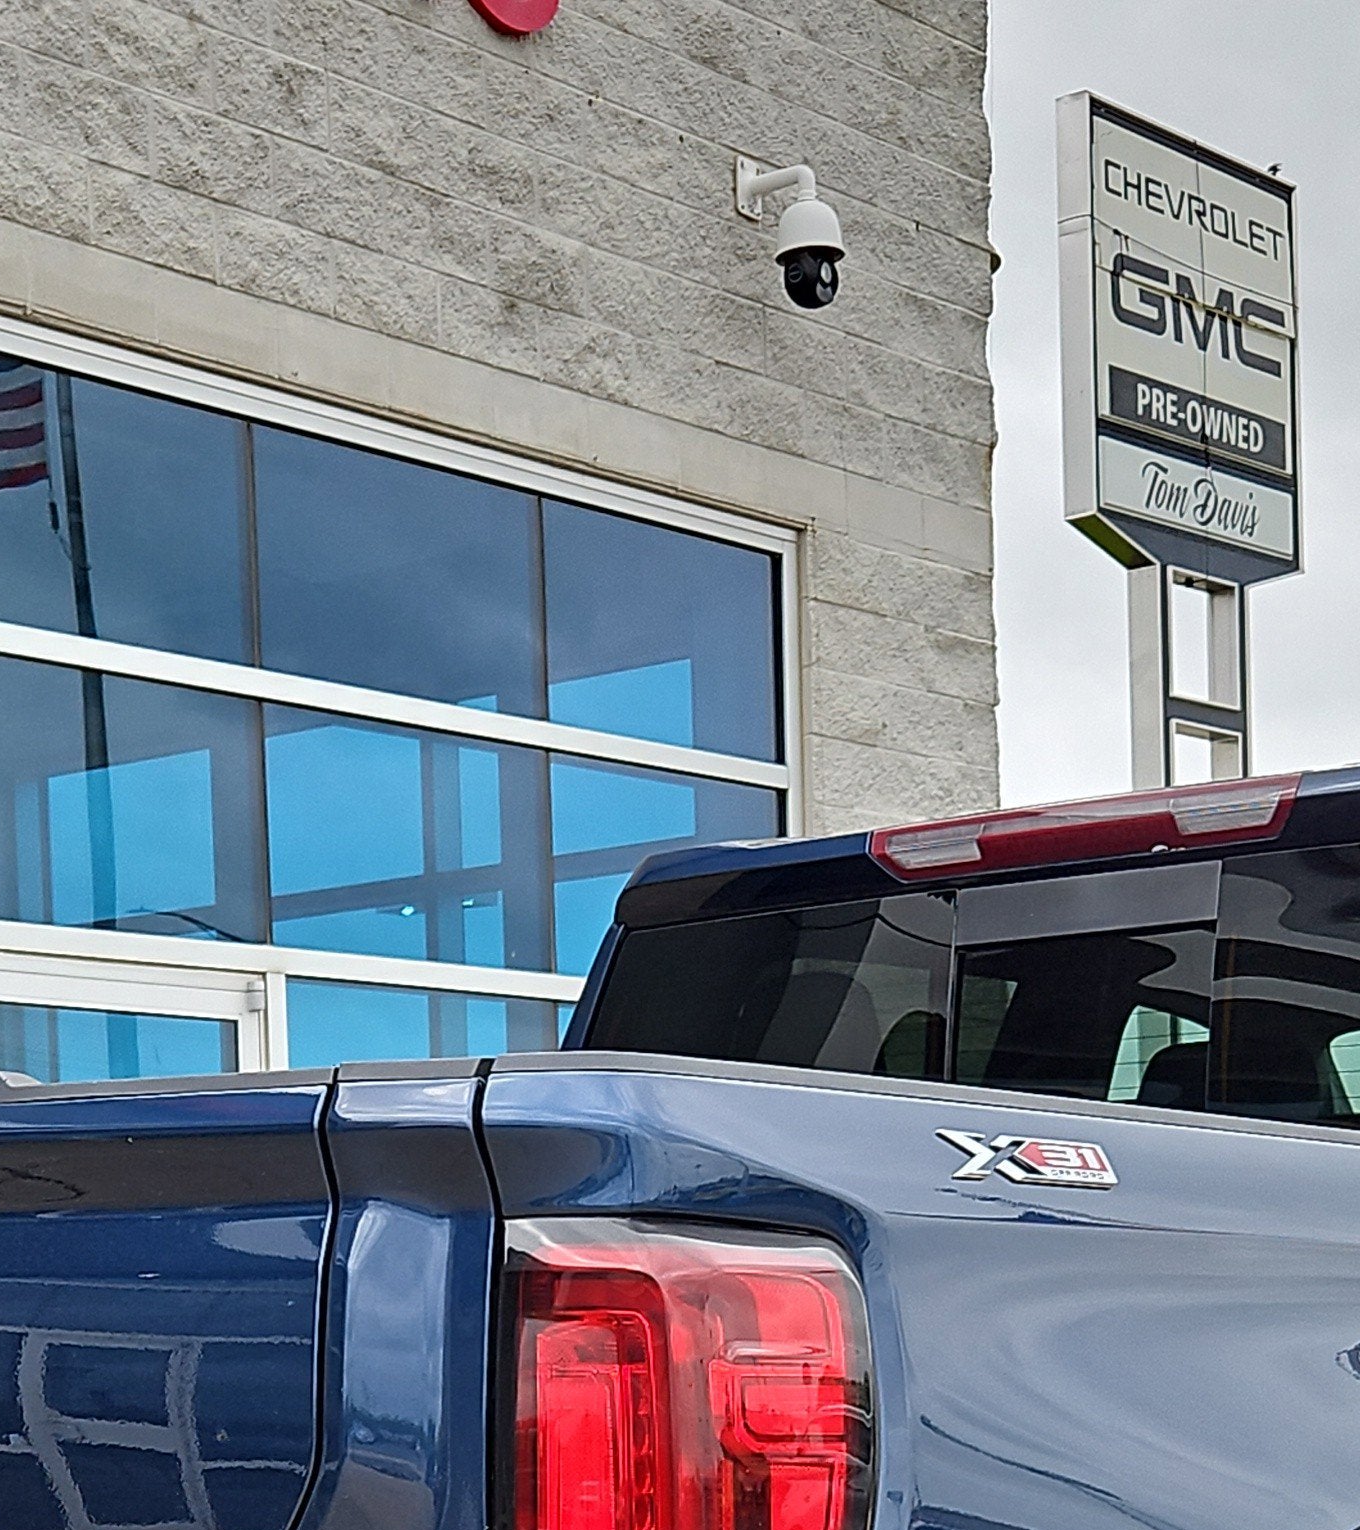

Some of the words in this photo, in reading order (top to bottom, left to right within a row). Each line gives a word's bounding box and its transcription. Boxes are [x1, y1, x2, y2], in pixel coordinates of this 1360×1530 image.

[1103, 157, 1286, 263] CHEVROLET
[1110, 252, 1286, 379] GMC
[1136, 382, 1265, 455] PRE-OWNED
[1141, 461, 1189, 516] Tom
[1191, 478, 1260, 538] Davis
